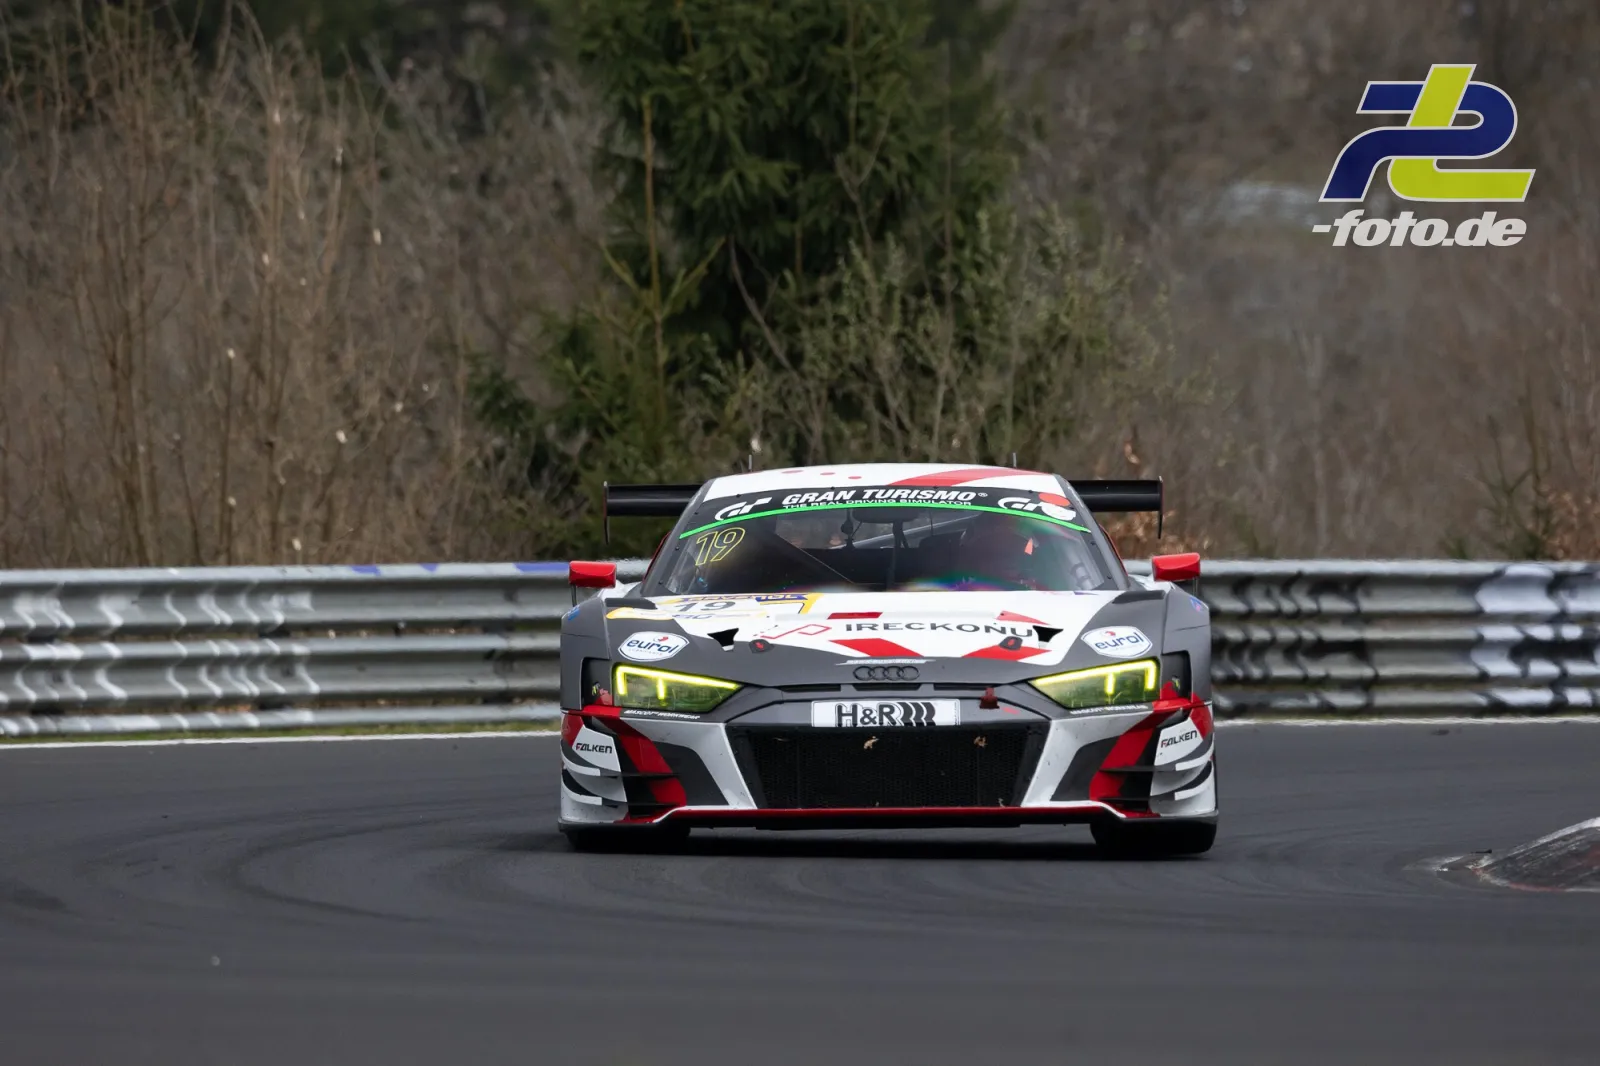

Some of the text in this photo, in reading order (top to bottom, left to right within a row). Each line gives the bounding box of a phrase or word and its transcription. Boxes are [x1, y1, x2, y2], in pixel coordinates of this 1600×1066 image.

[782, 489, 857, 505] GRAN
[899, 498, 972, 506] SIMULATOR
[695, 526, 746, 566] 19
[673, 600, 736, 612] 19
[845, 622, 1033, 638] IRECKONU
[626, 639, 680, 654] eurol
[1095, 632, 1144, 649] eurol
[836, 703, 898, 727] H&R
[1160, 730, 1198, 748] FALKEN
[575, 742, 613, 754] FALKEN
